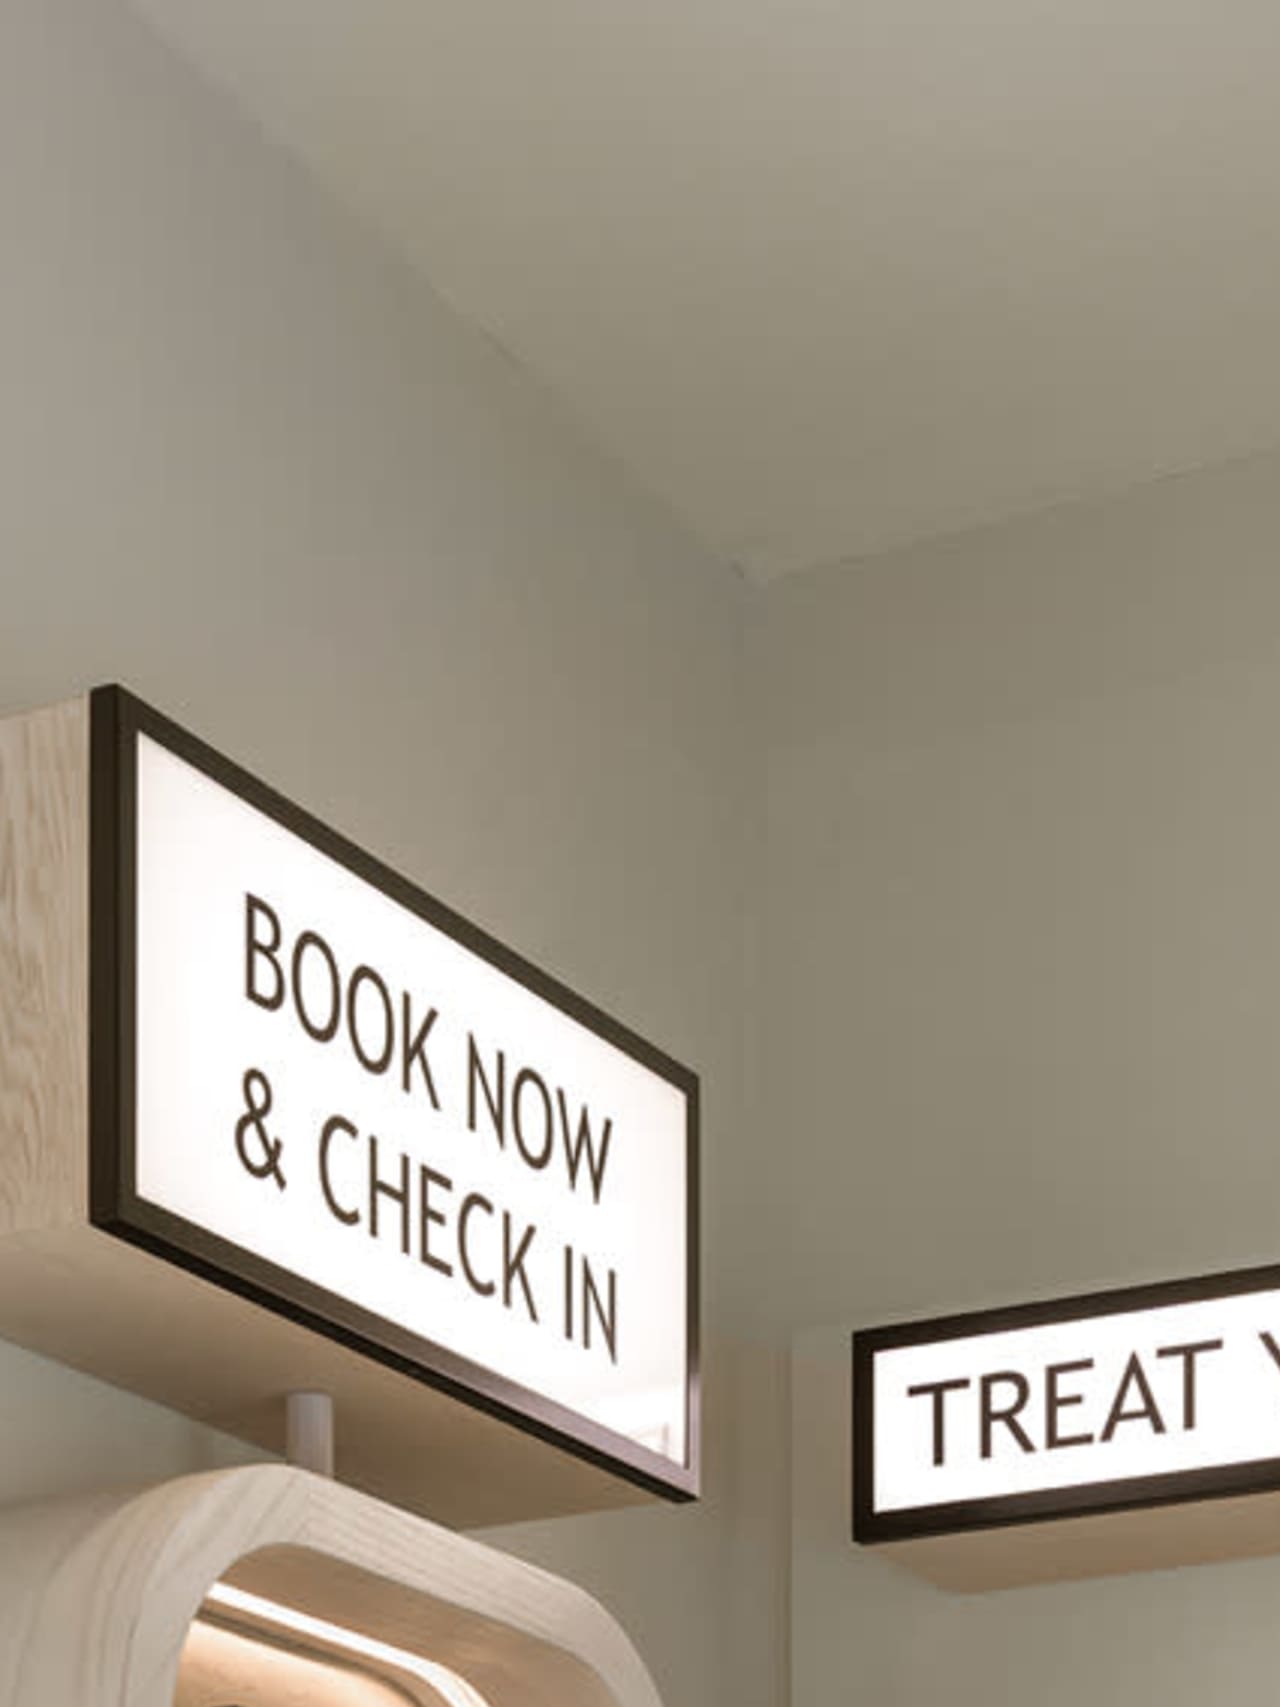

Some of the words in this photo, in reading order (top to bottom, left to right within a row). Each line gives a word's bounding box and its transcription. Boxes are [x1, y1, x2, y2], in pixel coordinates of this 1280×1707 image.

[245, 892, 441, 1111] BOOK
[467, 1031, 613, 1205] NOW
[234, 1067, 287, 1191] &
[318, 1115, 538, 1323] CHECK
[564, 1245, 617, 1364] IN
[907, 1337, 1223, 1467] TREAT
